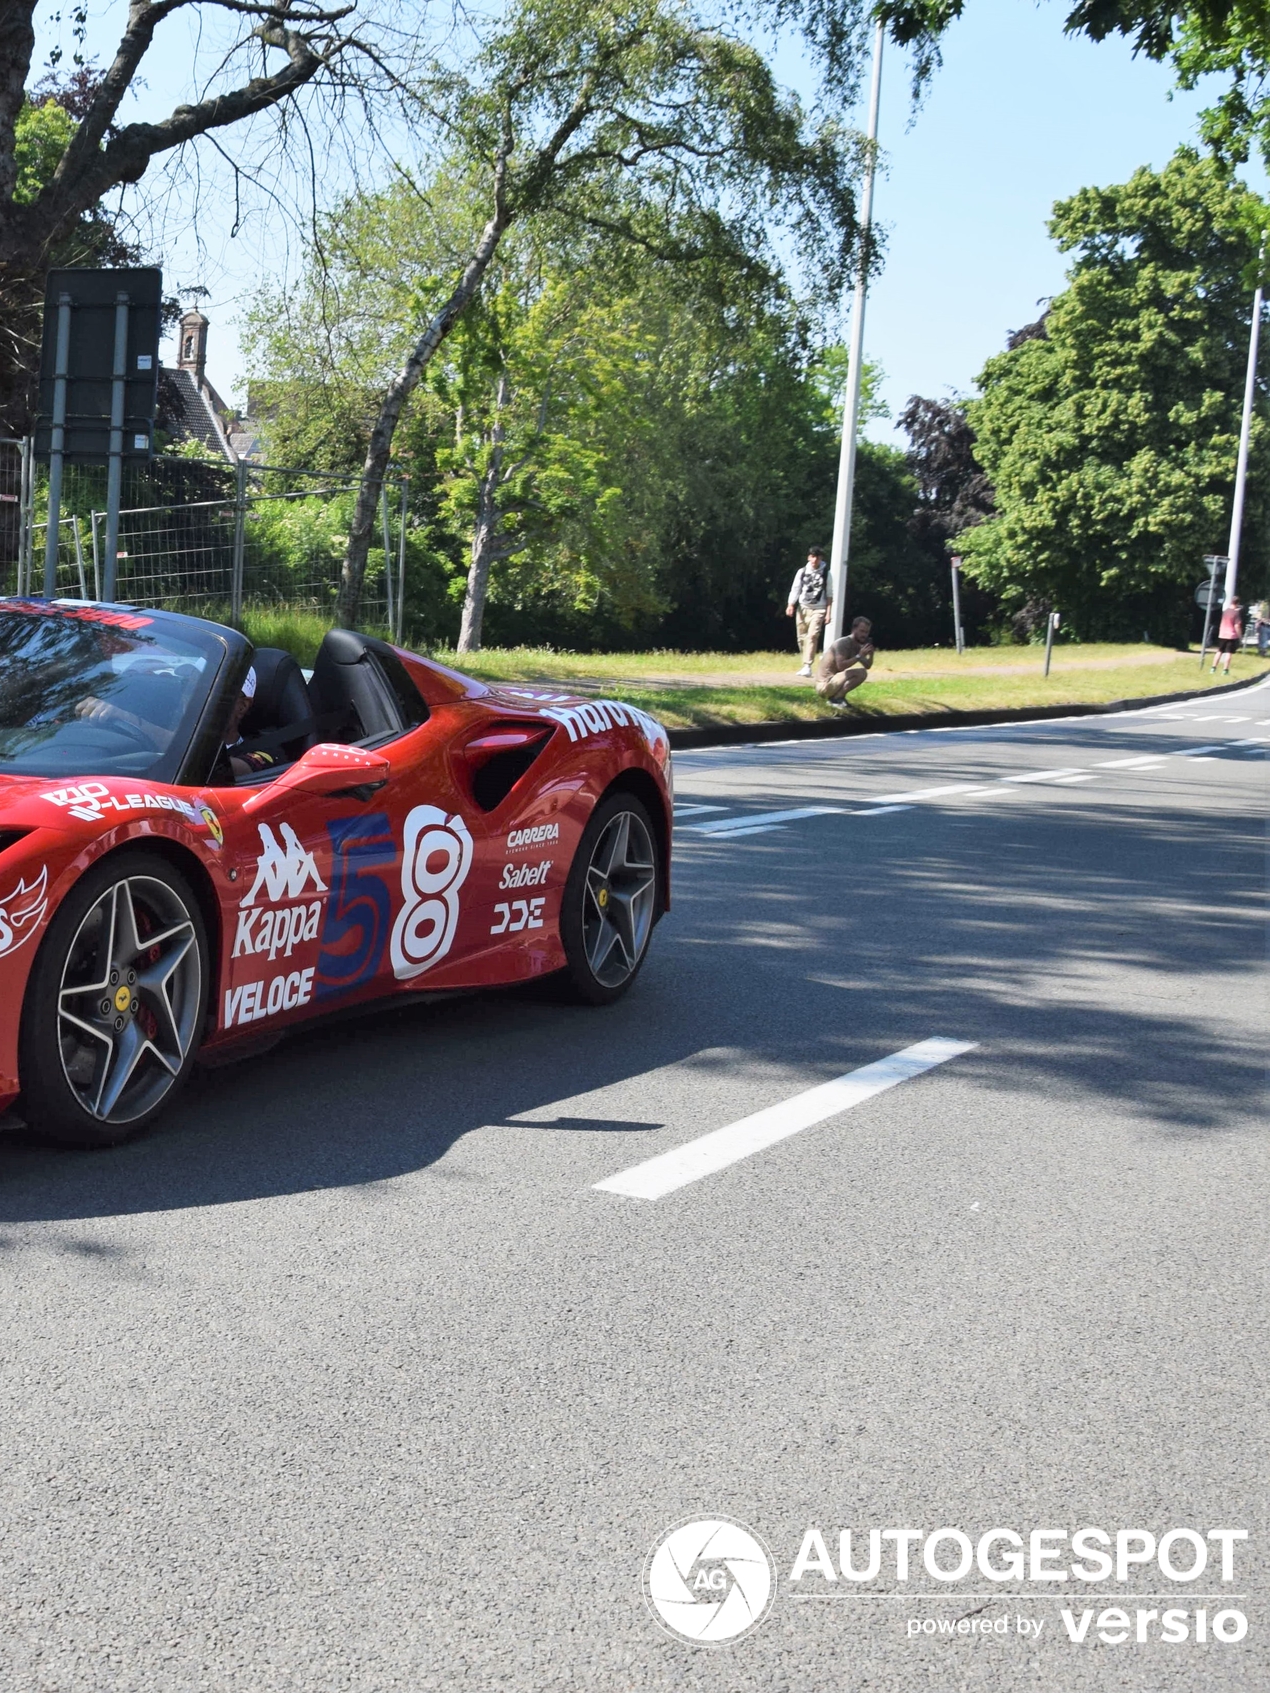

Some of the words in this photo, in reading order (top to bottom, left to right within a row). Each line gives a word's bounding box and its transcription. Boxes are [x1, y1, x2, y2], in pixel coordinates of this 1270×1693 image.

[539, 700, 628, 743] Hard
[507, 823, 559, 848] CARRERA
[499, 861, 552, 889] Sabelt
[231, 901, 322, 961] Kappa
[224, 966, 316, 1029] VELOCE
